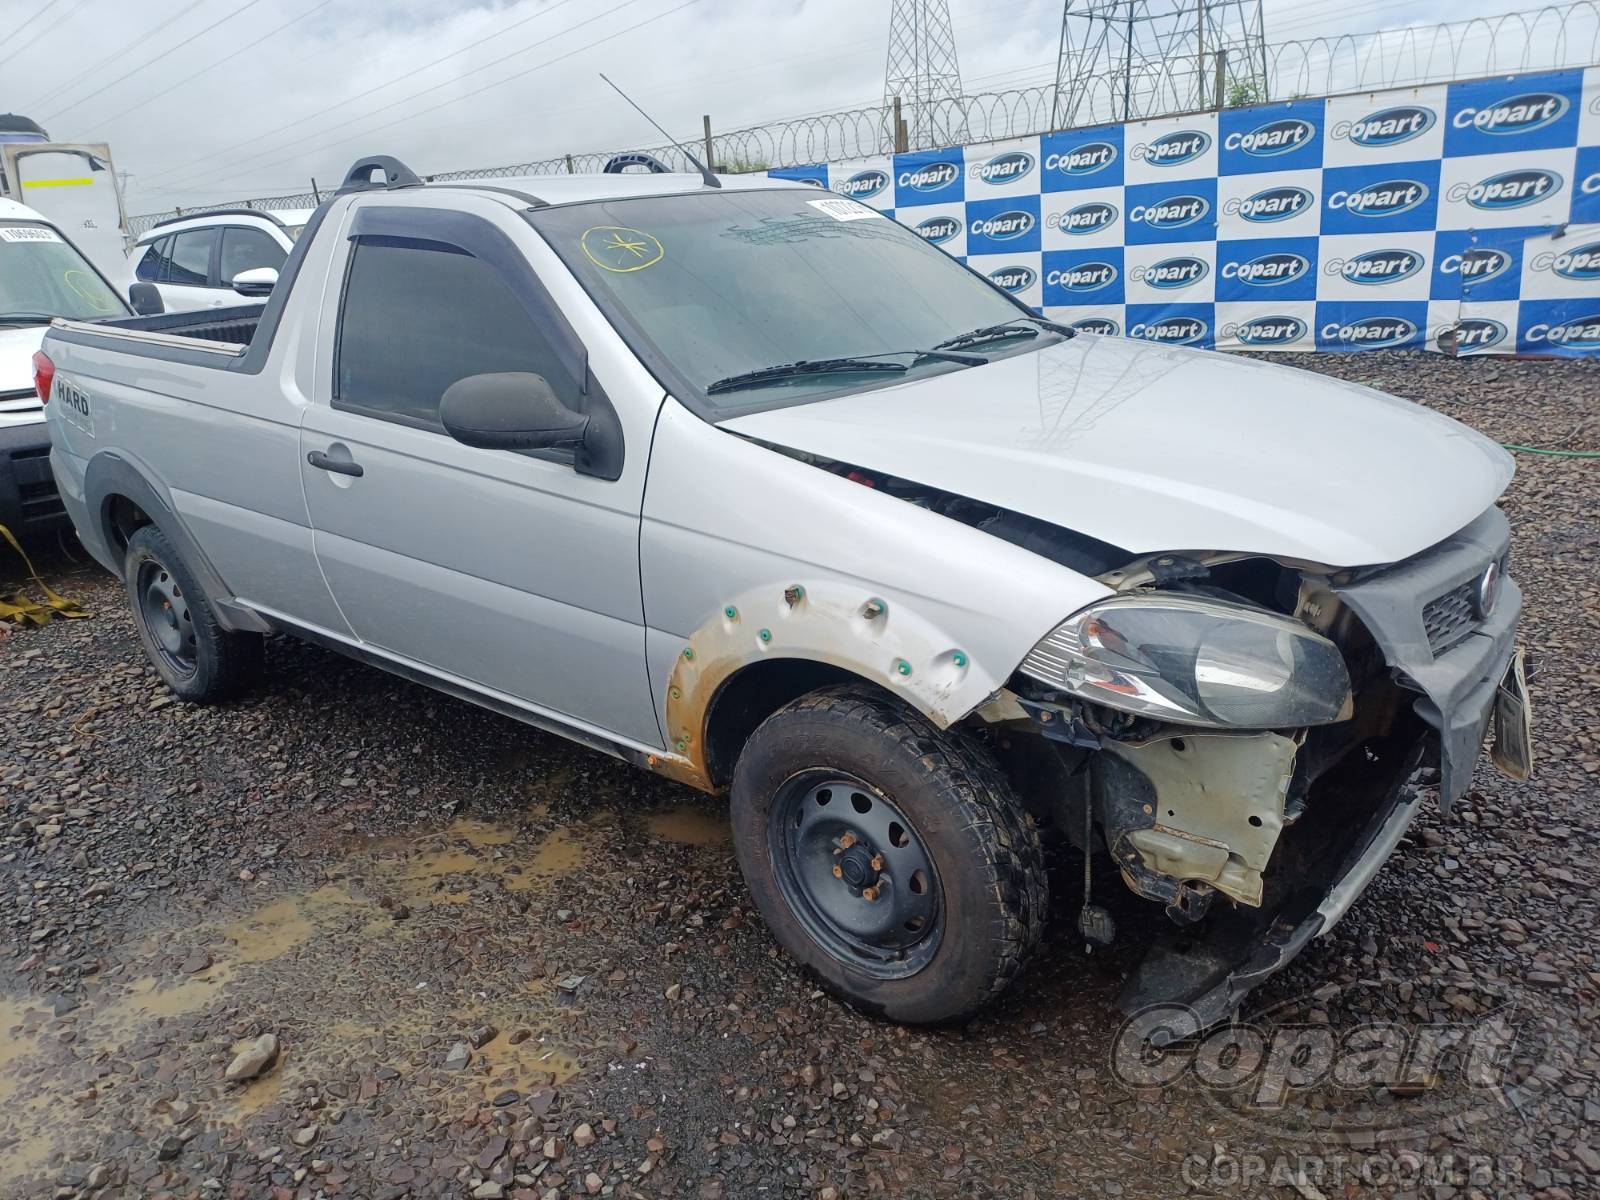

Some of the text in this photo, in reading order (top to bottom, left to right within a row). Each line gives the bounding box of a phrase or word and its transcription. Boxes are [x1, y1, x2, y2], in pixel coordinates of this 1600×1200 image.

[1453, 97, 1556, 128] Copart
[1225, 125, 1304, 150] Copart
[1331, 113, 1424, 140] Copart
[1045, 147, 1108, 171] Copart
[1130, 135, 1201, 160] Copart
[899, 166, 953, 191] Copart
[969, 155, 1028, 178] Copart
[833, 176, 882, 195] Copart
[1328, 186, 1417, 209] Copart
[1446, 176, 1549, 203] Copart
[1130, 200, 1200, 225] Copart
[1223, 193, 1301, 217] Copart
[971, 211, 1028, 236] Copart
[1046, 206, 1109, 229] Copart
[1130, 260, 1200, 285] Copart
[1221, 259, 1299, 283] Copart
[1324, 255, 1411, 277] Copart
[1530, 250, 1600, 273] Copa
[1046, 265, 1109, 289] Copart
[1130, 322, 1198, 340] Copart
[1221, 319, 1300, 341] Copart
[1321, 321, 1408, 341] Copart
[1525, 323, 1600, 343] Copa
[58, 380, 89, 417] HARD
